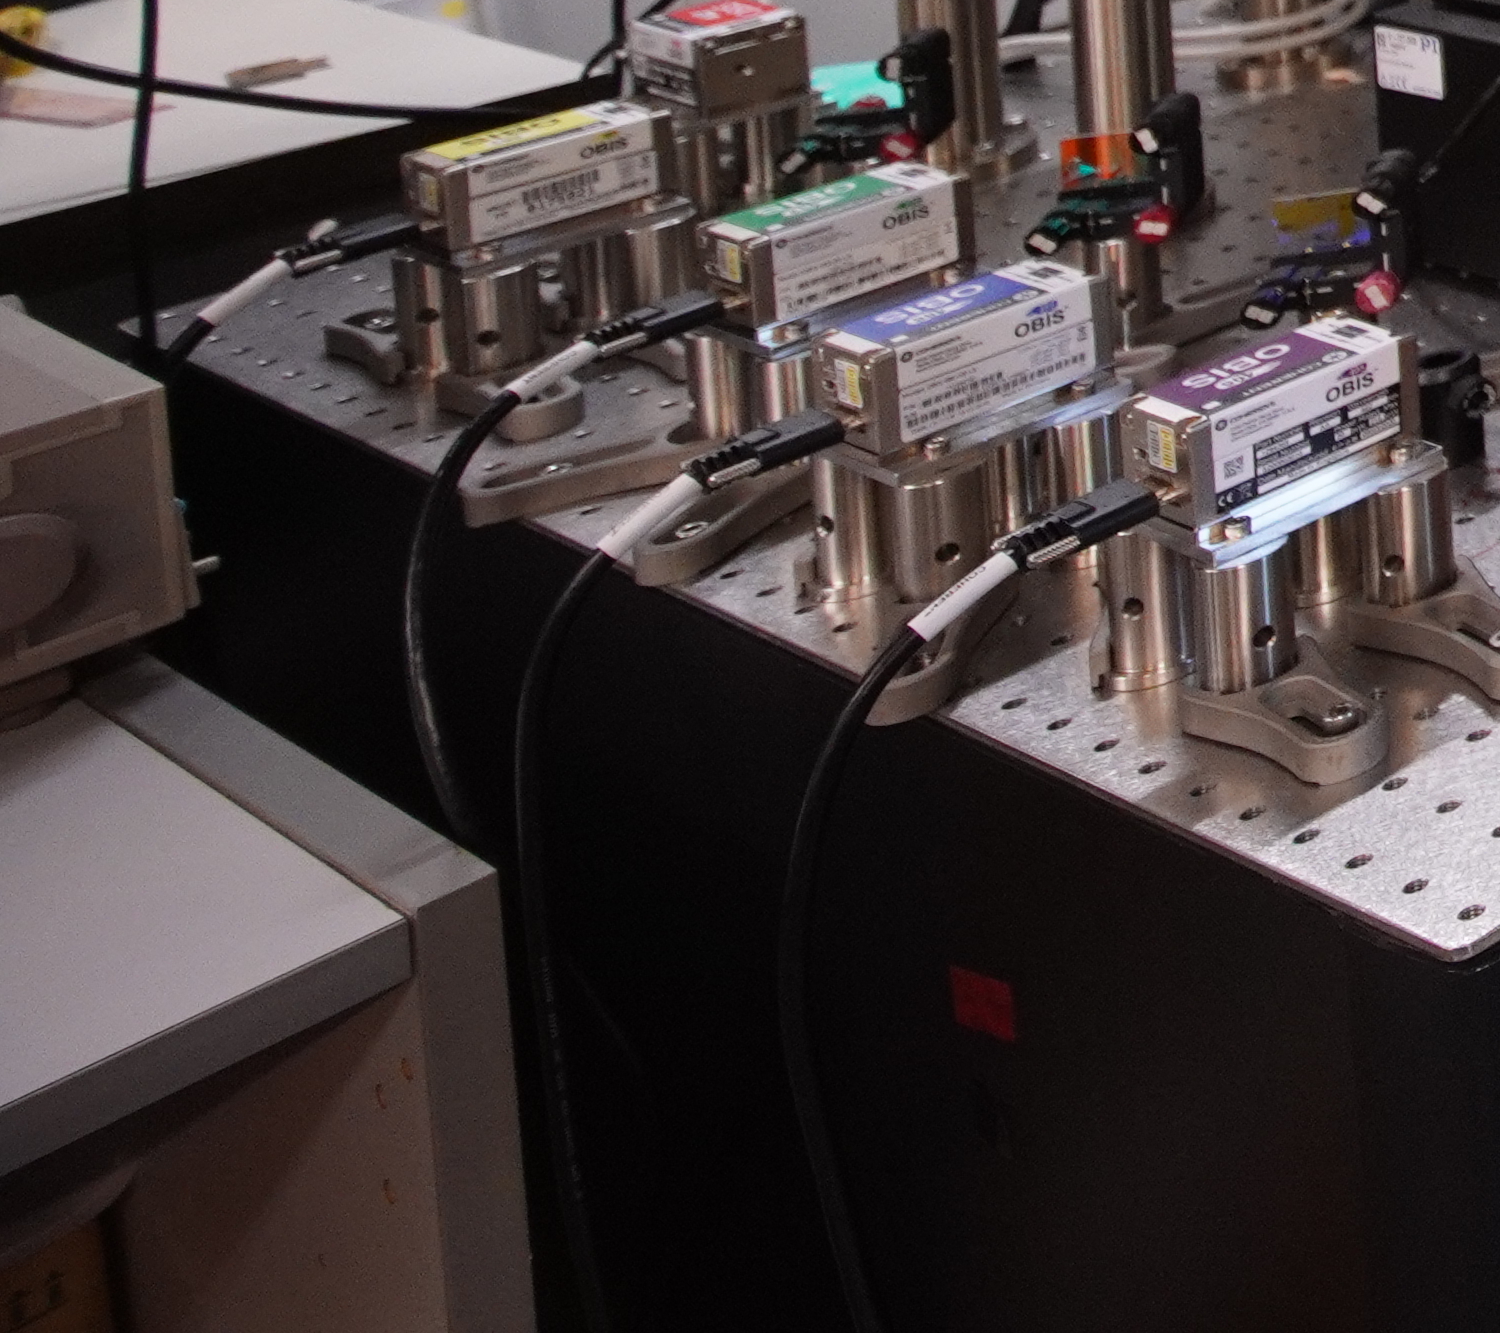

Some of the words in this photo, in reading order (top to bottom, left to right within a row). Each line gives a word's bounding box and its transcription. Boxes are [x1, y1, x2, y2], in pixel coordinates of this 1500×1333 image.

[1420, 37, 1438, 54] PI
[882, 205, 930, 230] OBIS
[874, 283, 986, 324] OBIS
[1015, 310, 1065, 337] OBIS
[1182, 343, 1291, 390] OBIS
[1326, 372, 1374, 403] OBIS
